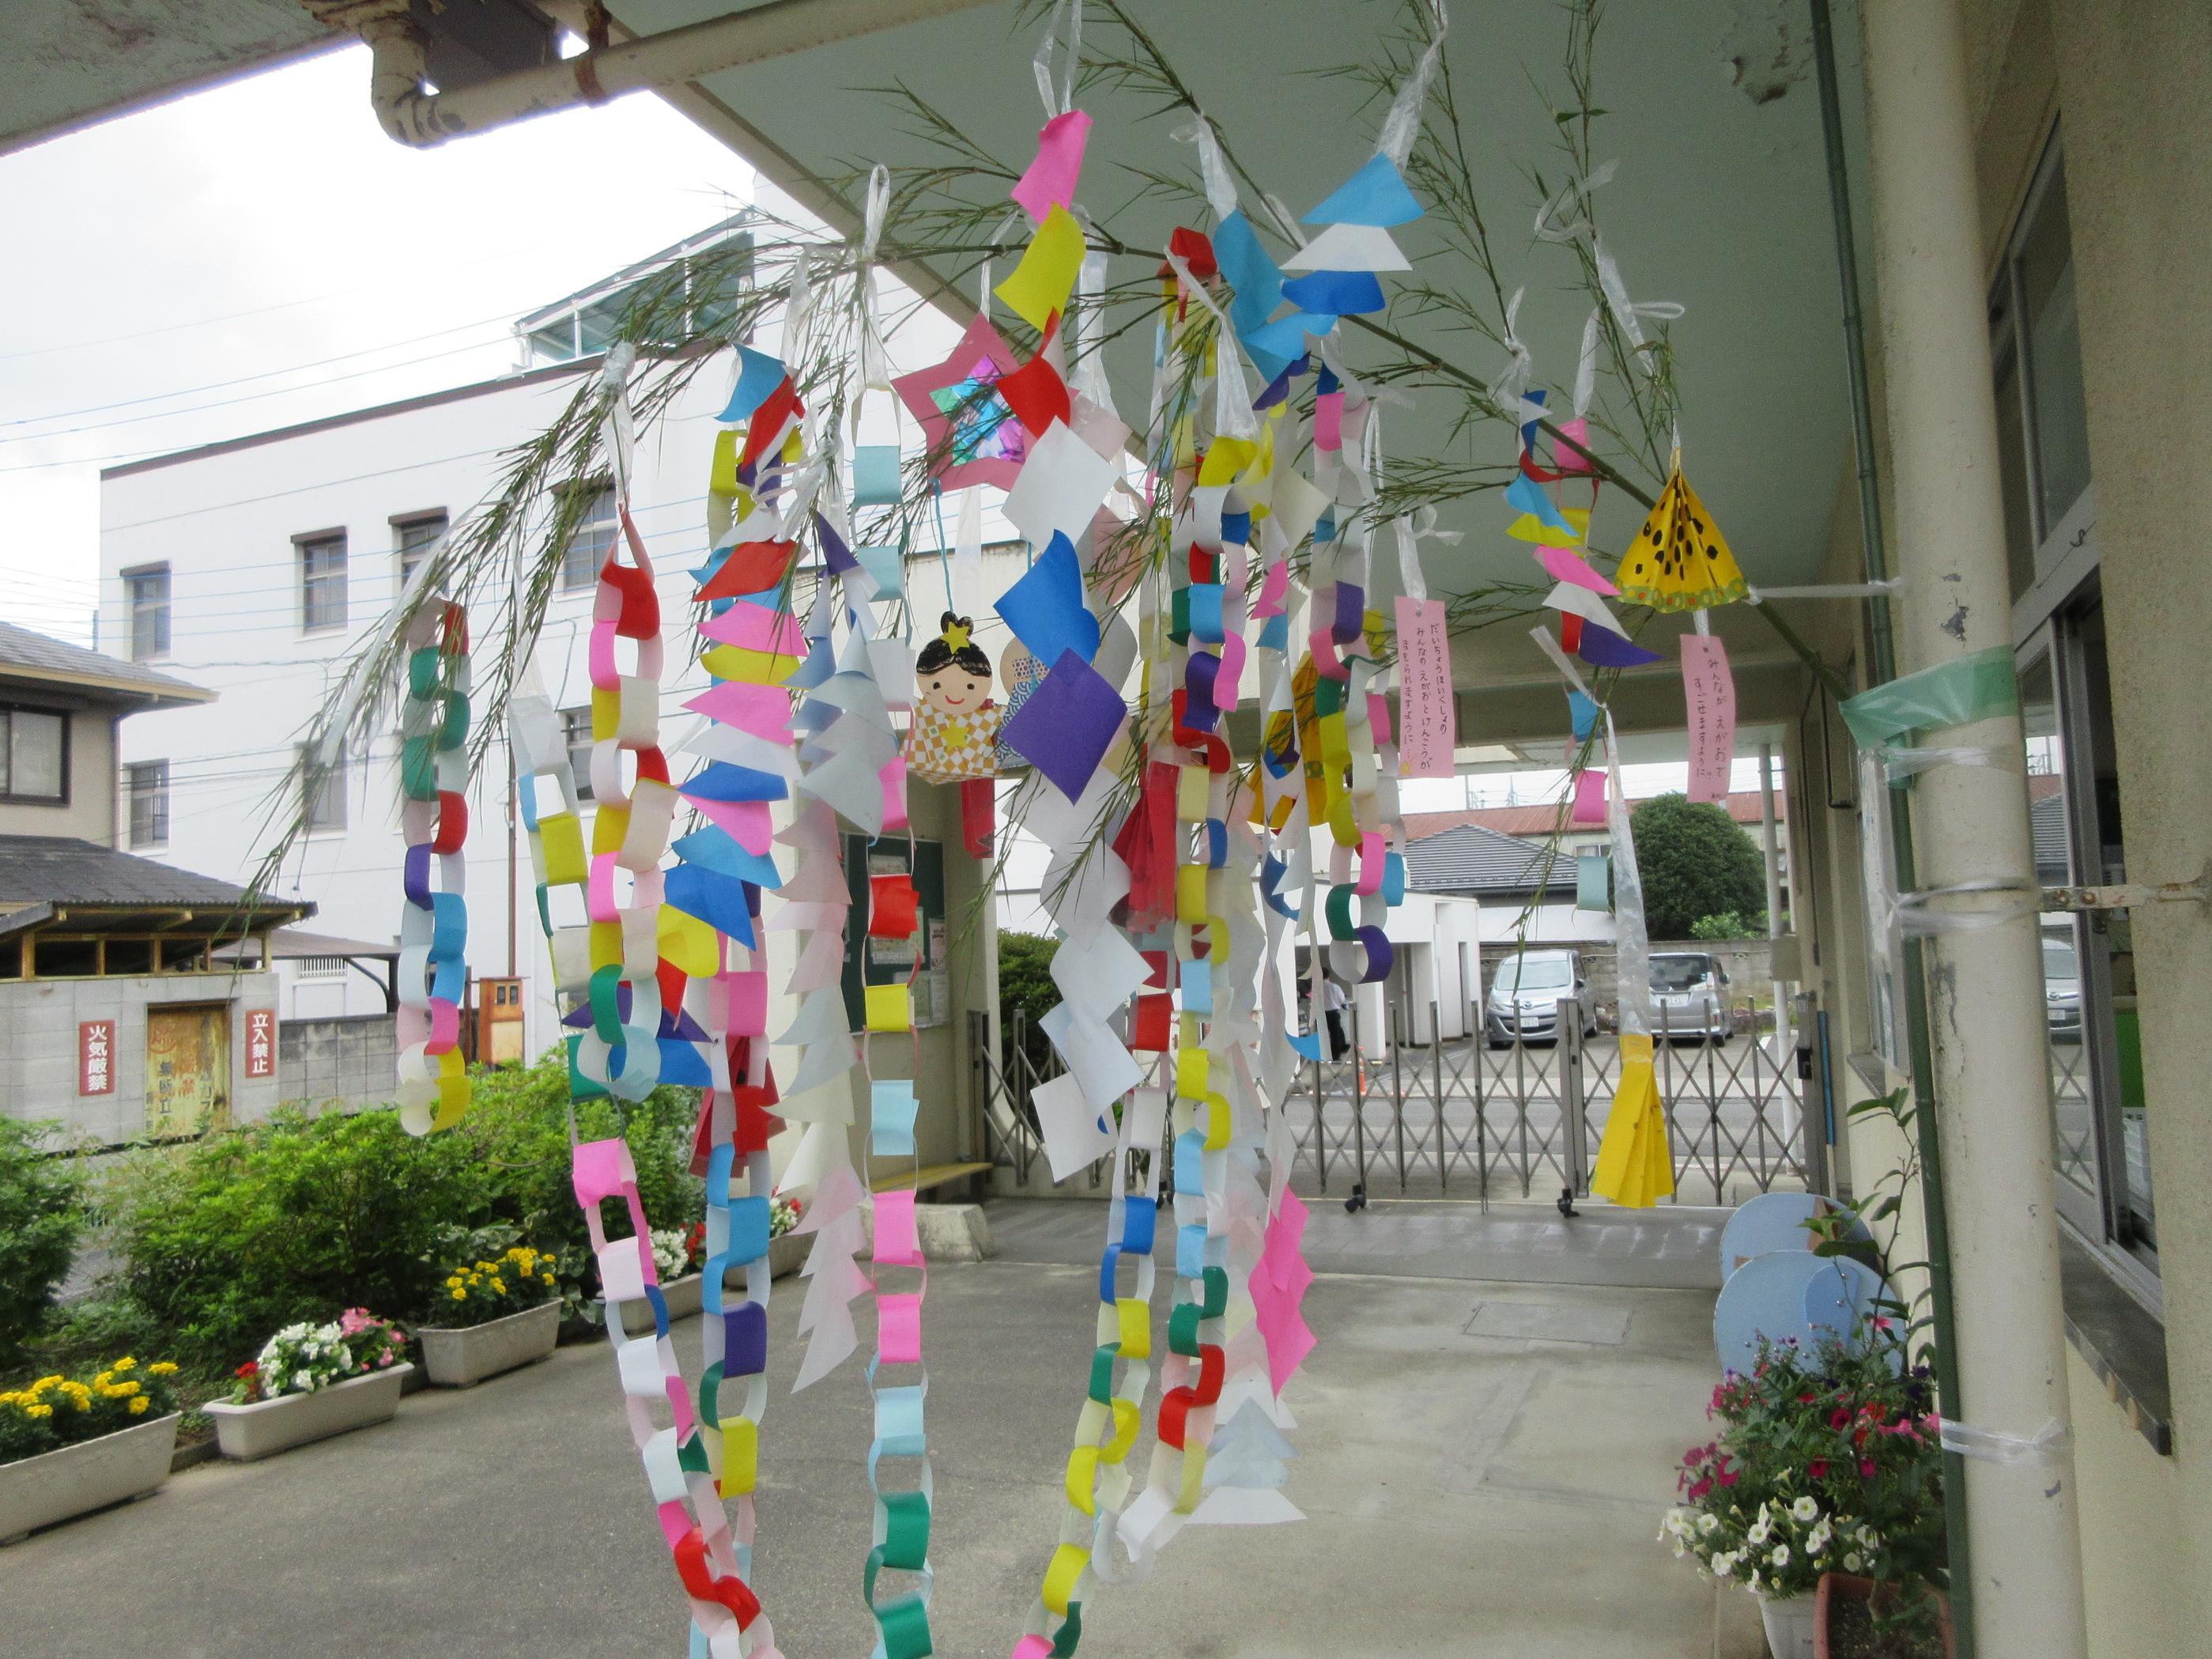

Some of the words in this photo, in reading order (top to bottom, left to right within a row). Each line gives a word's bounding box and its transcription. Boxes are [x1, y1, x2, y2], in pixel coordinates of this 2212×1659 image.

[88, 1025, 108, 1091] 火気厳禁
[252, 1013, 269, 1074] 立入禁止
